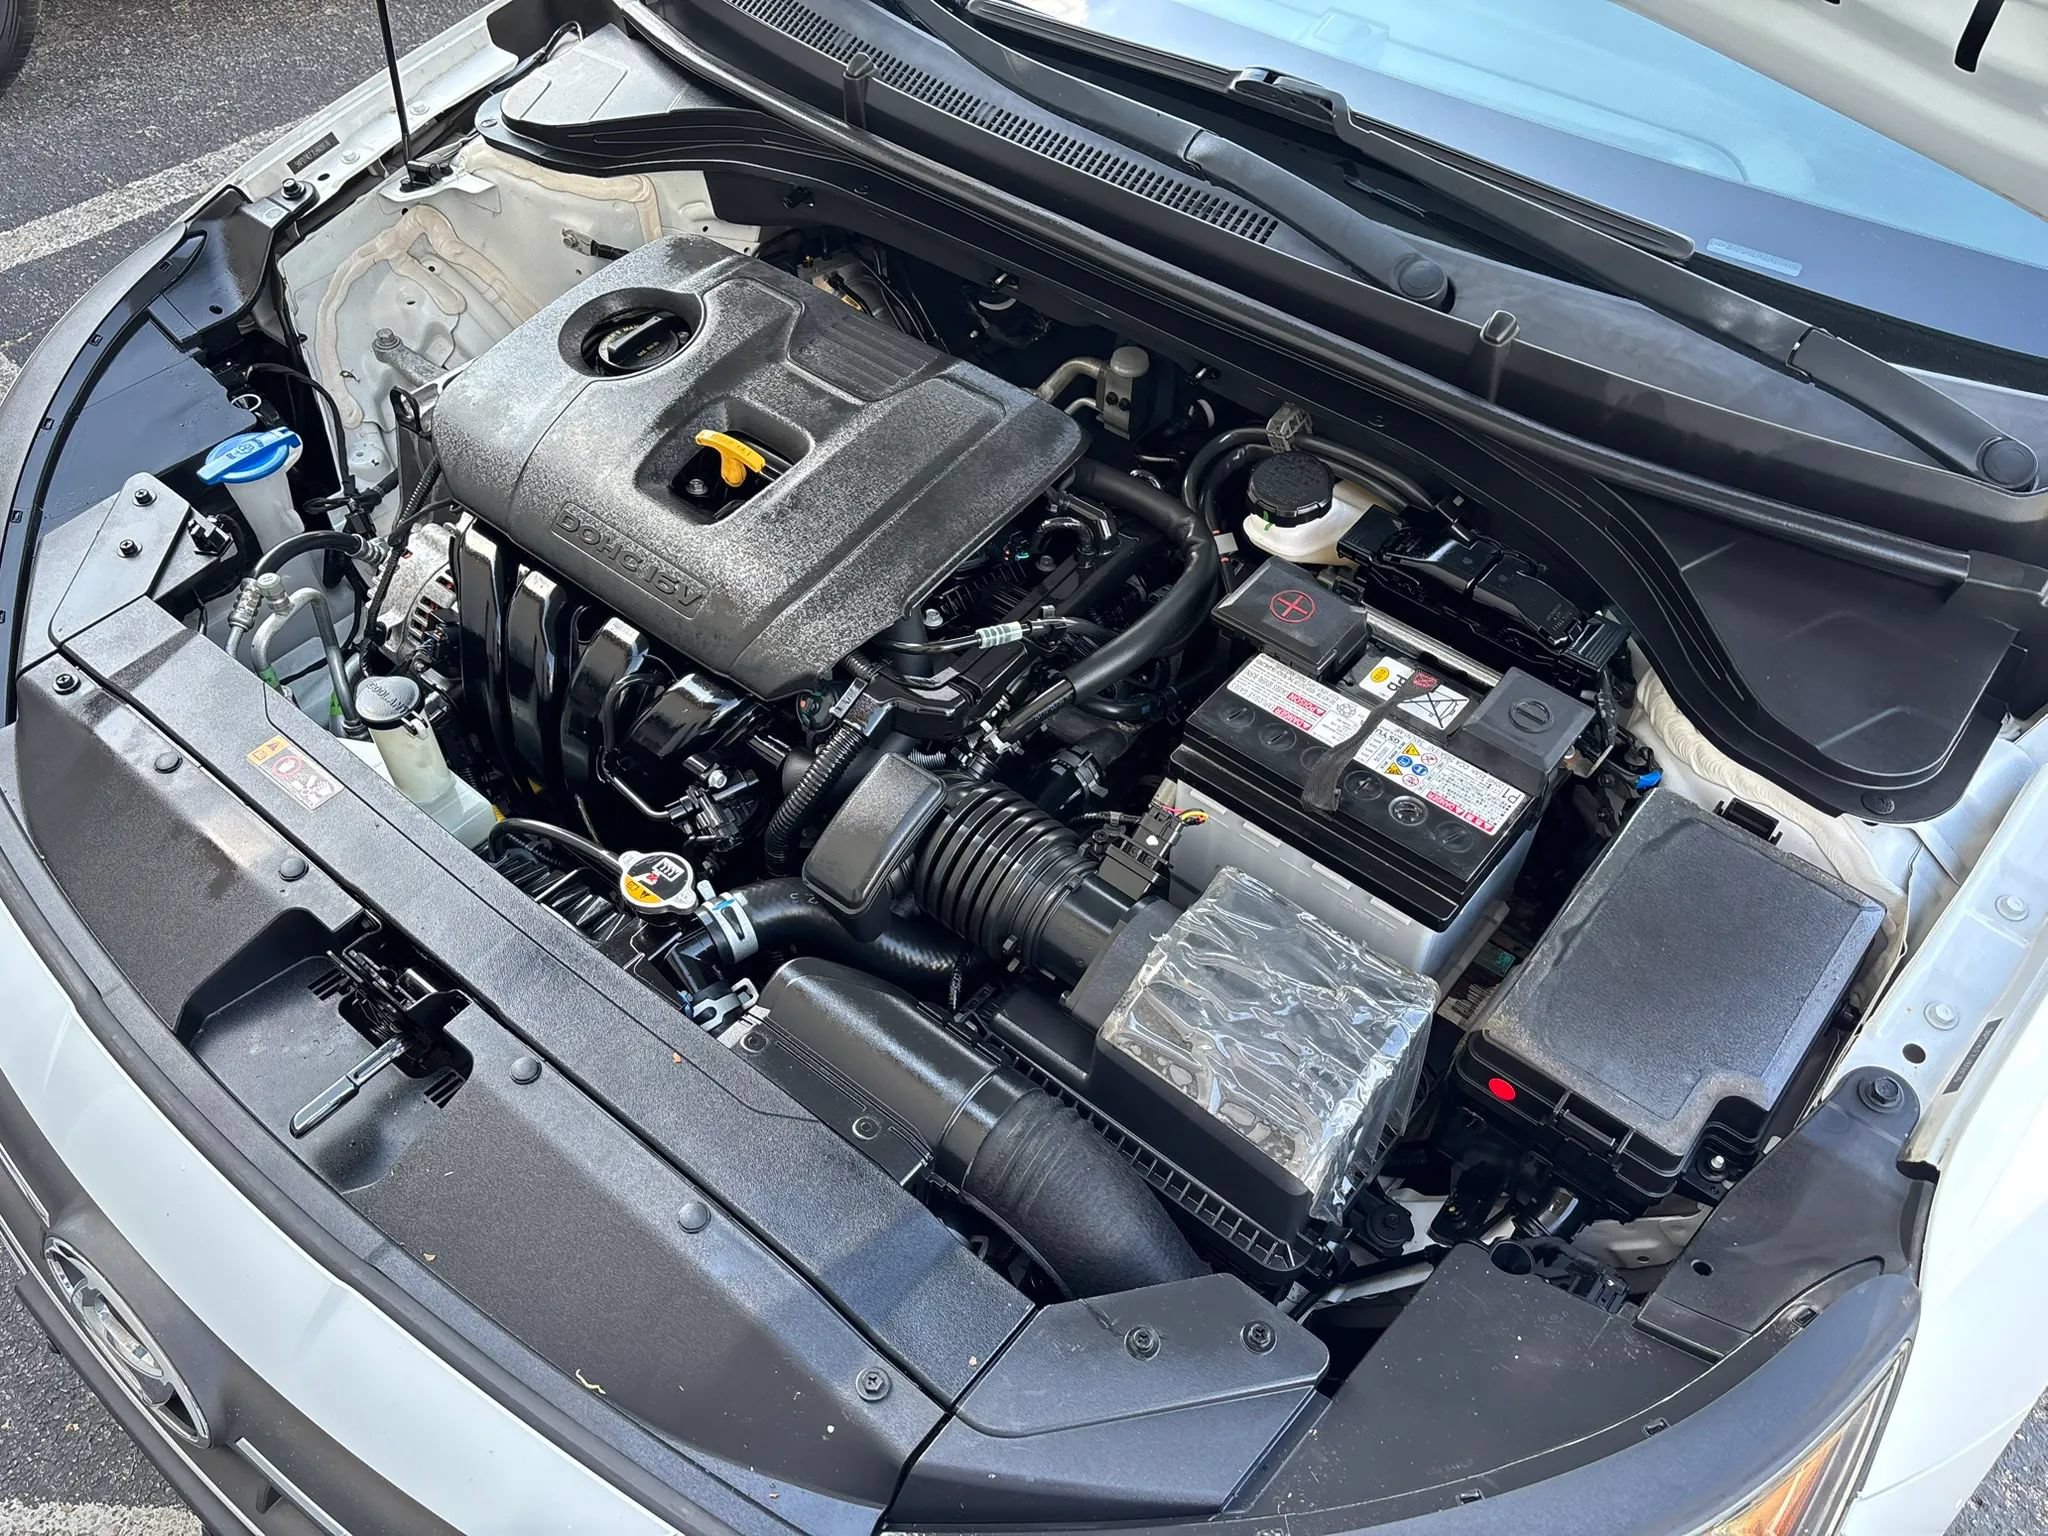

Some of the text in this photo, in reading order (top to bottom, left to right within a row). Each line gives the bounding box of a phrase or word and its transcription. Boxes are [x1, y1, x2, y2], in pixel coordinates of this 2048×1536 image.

[556, 512, 702, 606] DOHC 16V
[1387, 674, 1408, 692] Pb
[367, 682, 408, 714] COOLANT
[1286, 691, 1317, 711] POISON
[1273, 705, 1304, 726] DANGER
[1387, 734, 1400, 744] GS
[1426, 791, 1456, 810] DANGER
[1499, 786, 1521, 804] P1
